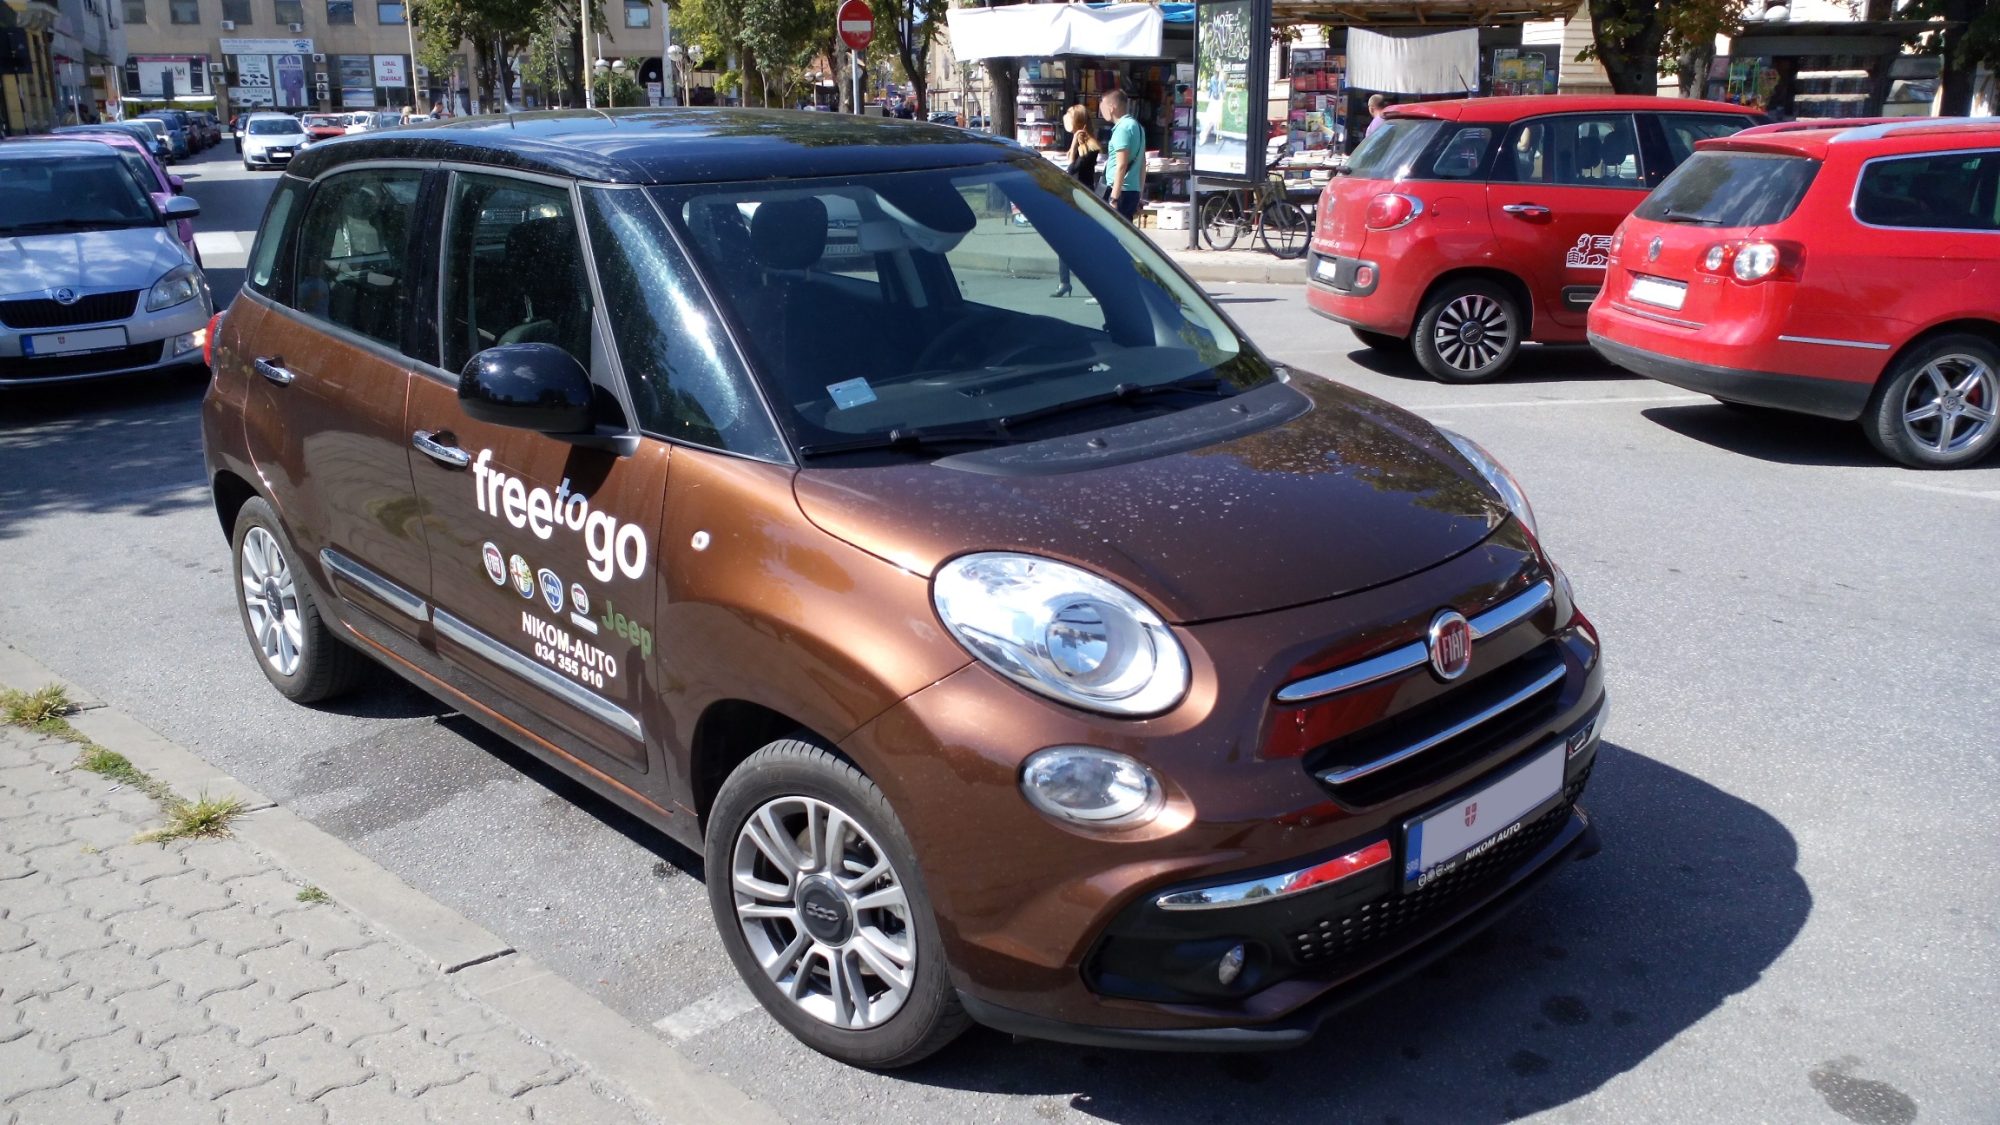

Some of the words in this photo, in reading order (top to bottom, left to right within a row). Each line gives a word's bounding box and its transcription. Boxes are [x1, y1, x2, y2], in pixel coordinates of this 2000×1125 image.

[522, 611, 617, 678] NIKOM-AUTO
[601, 600, 652, 659] Jeep
[1442, 629, 1464, 665] FIAT
[534, 642, 556, 665] 034
[558, 656, 579, 677] 355
[581, 667, 604, 689] 810
[1465, 837, 1496, 861] NIKOM
[1497, 822, 1521, 843] AUTO
